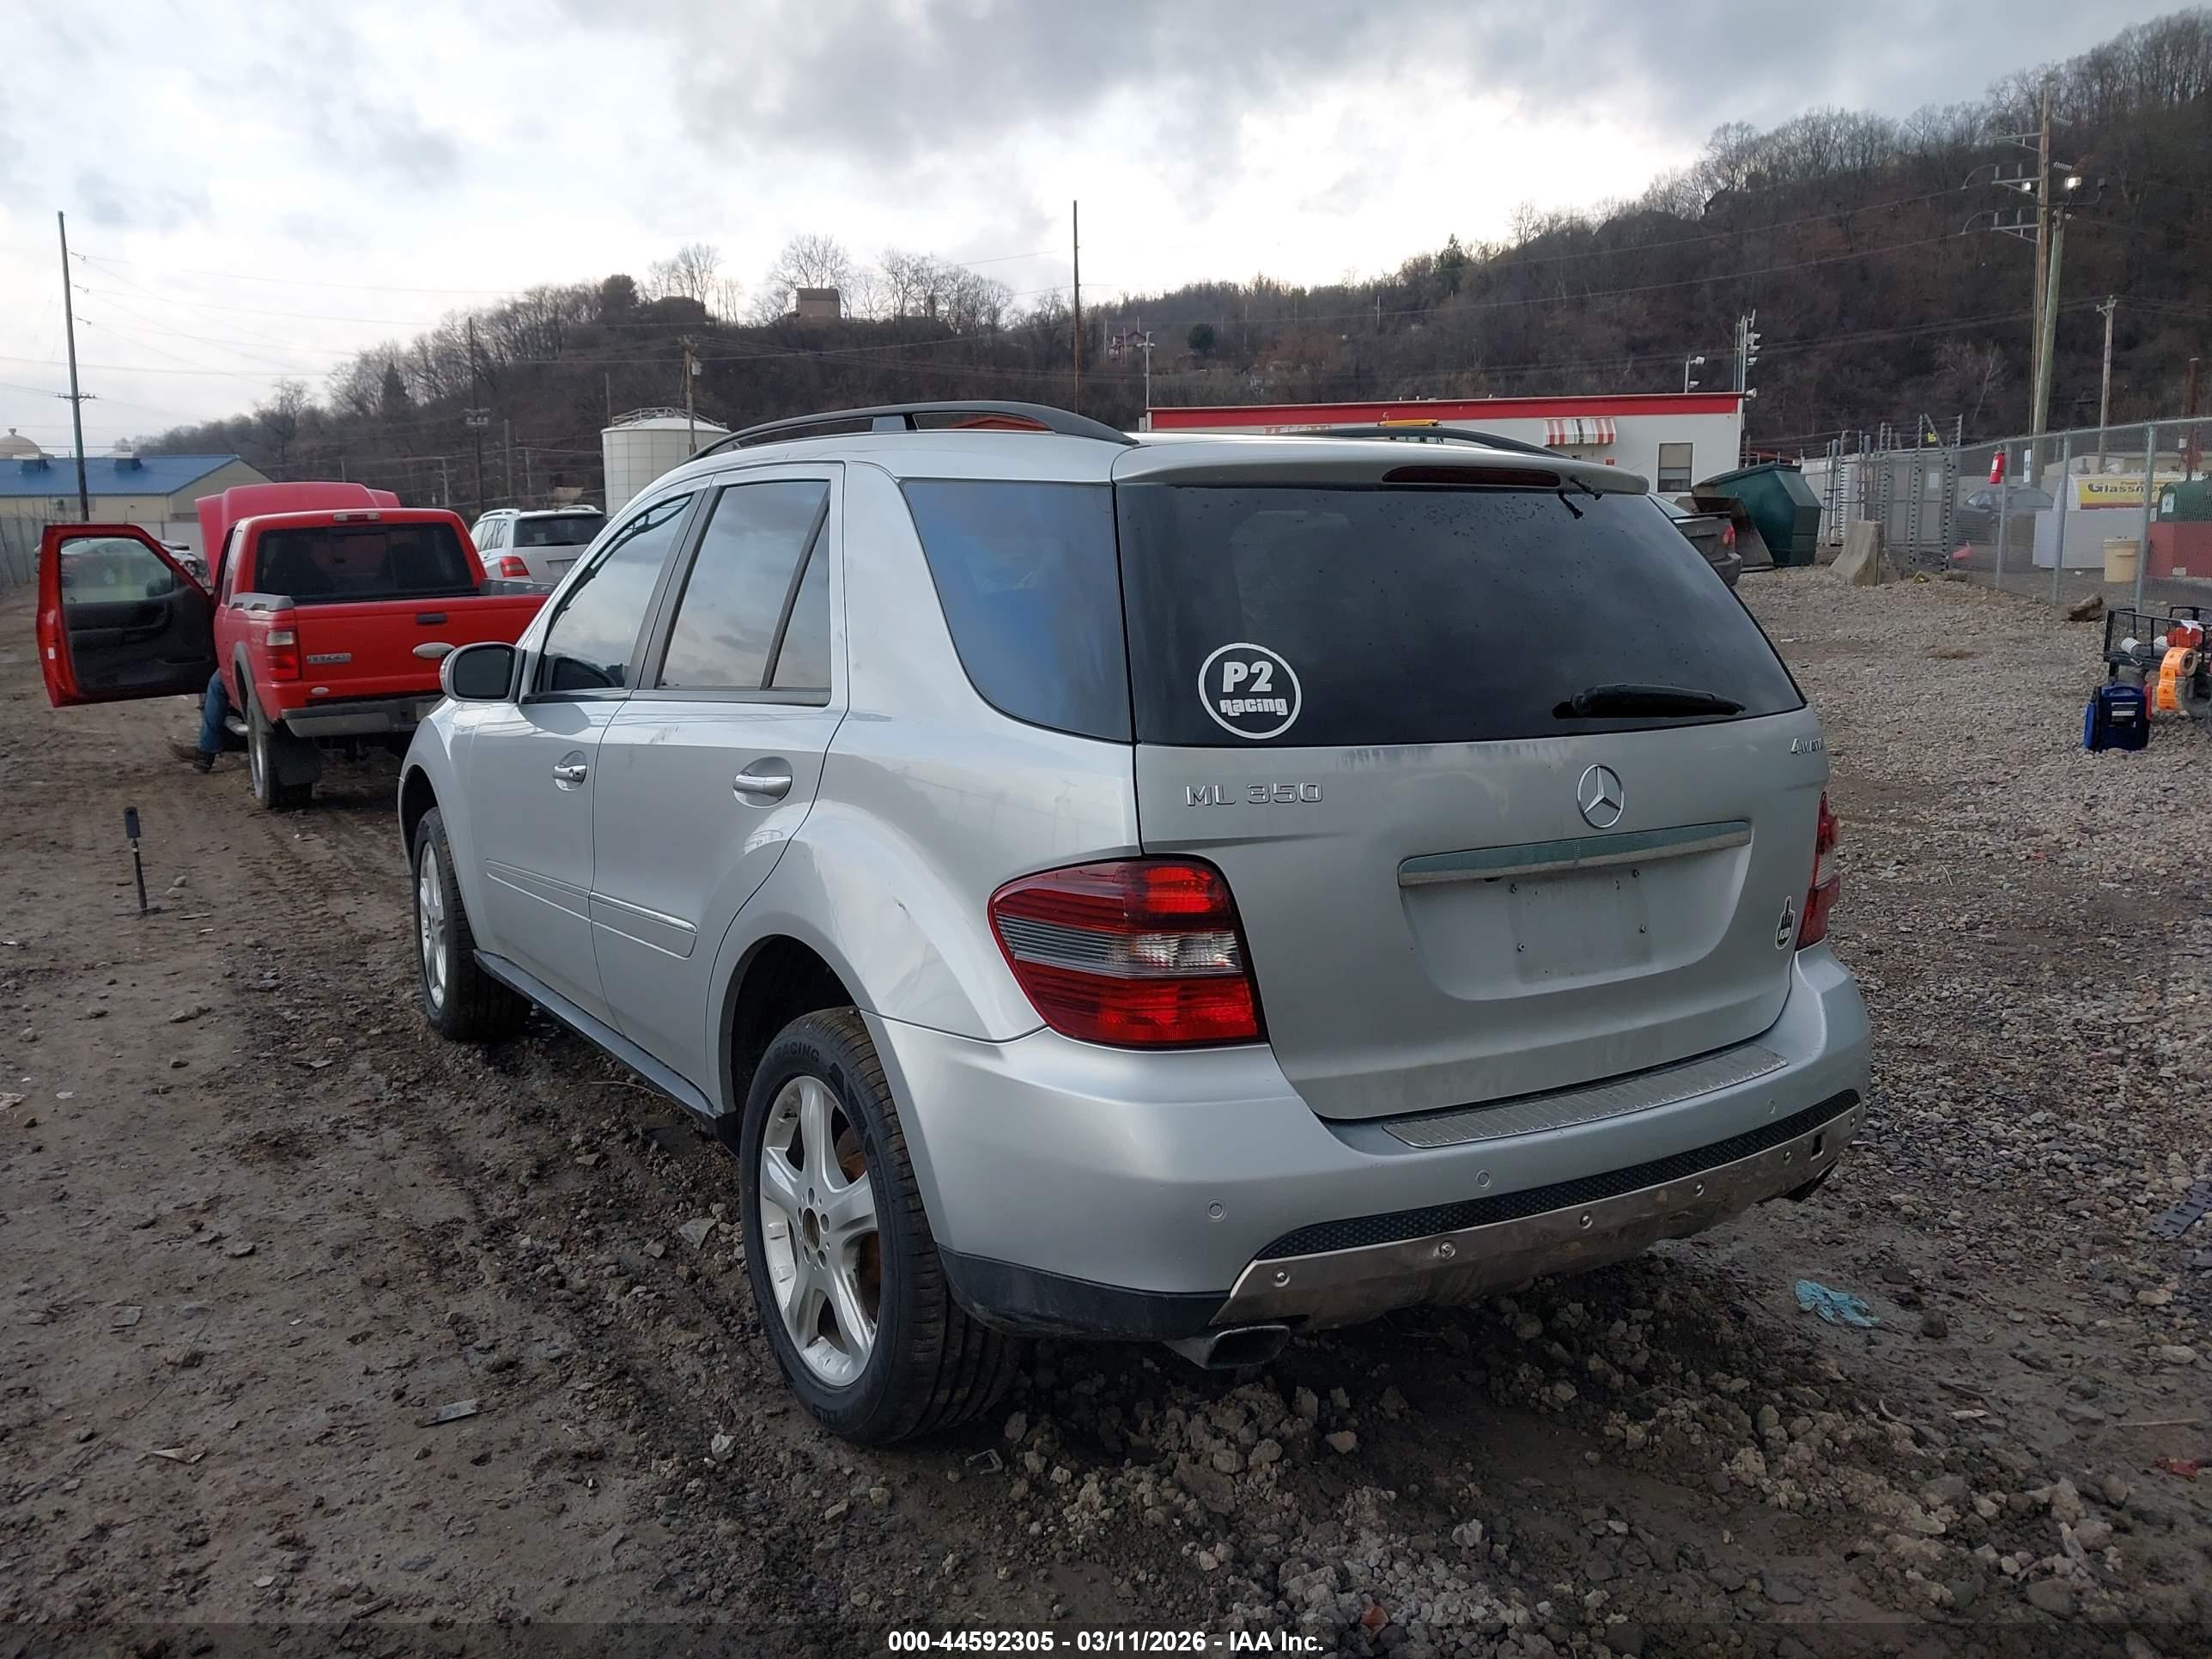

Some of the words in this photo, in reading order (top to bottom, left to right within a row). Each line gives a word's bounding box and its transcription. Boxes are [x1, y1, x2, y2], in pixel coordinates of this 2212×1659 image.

[1223, 661, 1273, 693] P2
[1219, 698, 1288, 717] Racing
[1186, 785, 1237, 806] ML
[1246, 782, 1323, 805] 350
